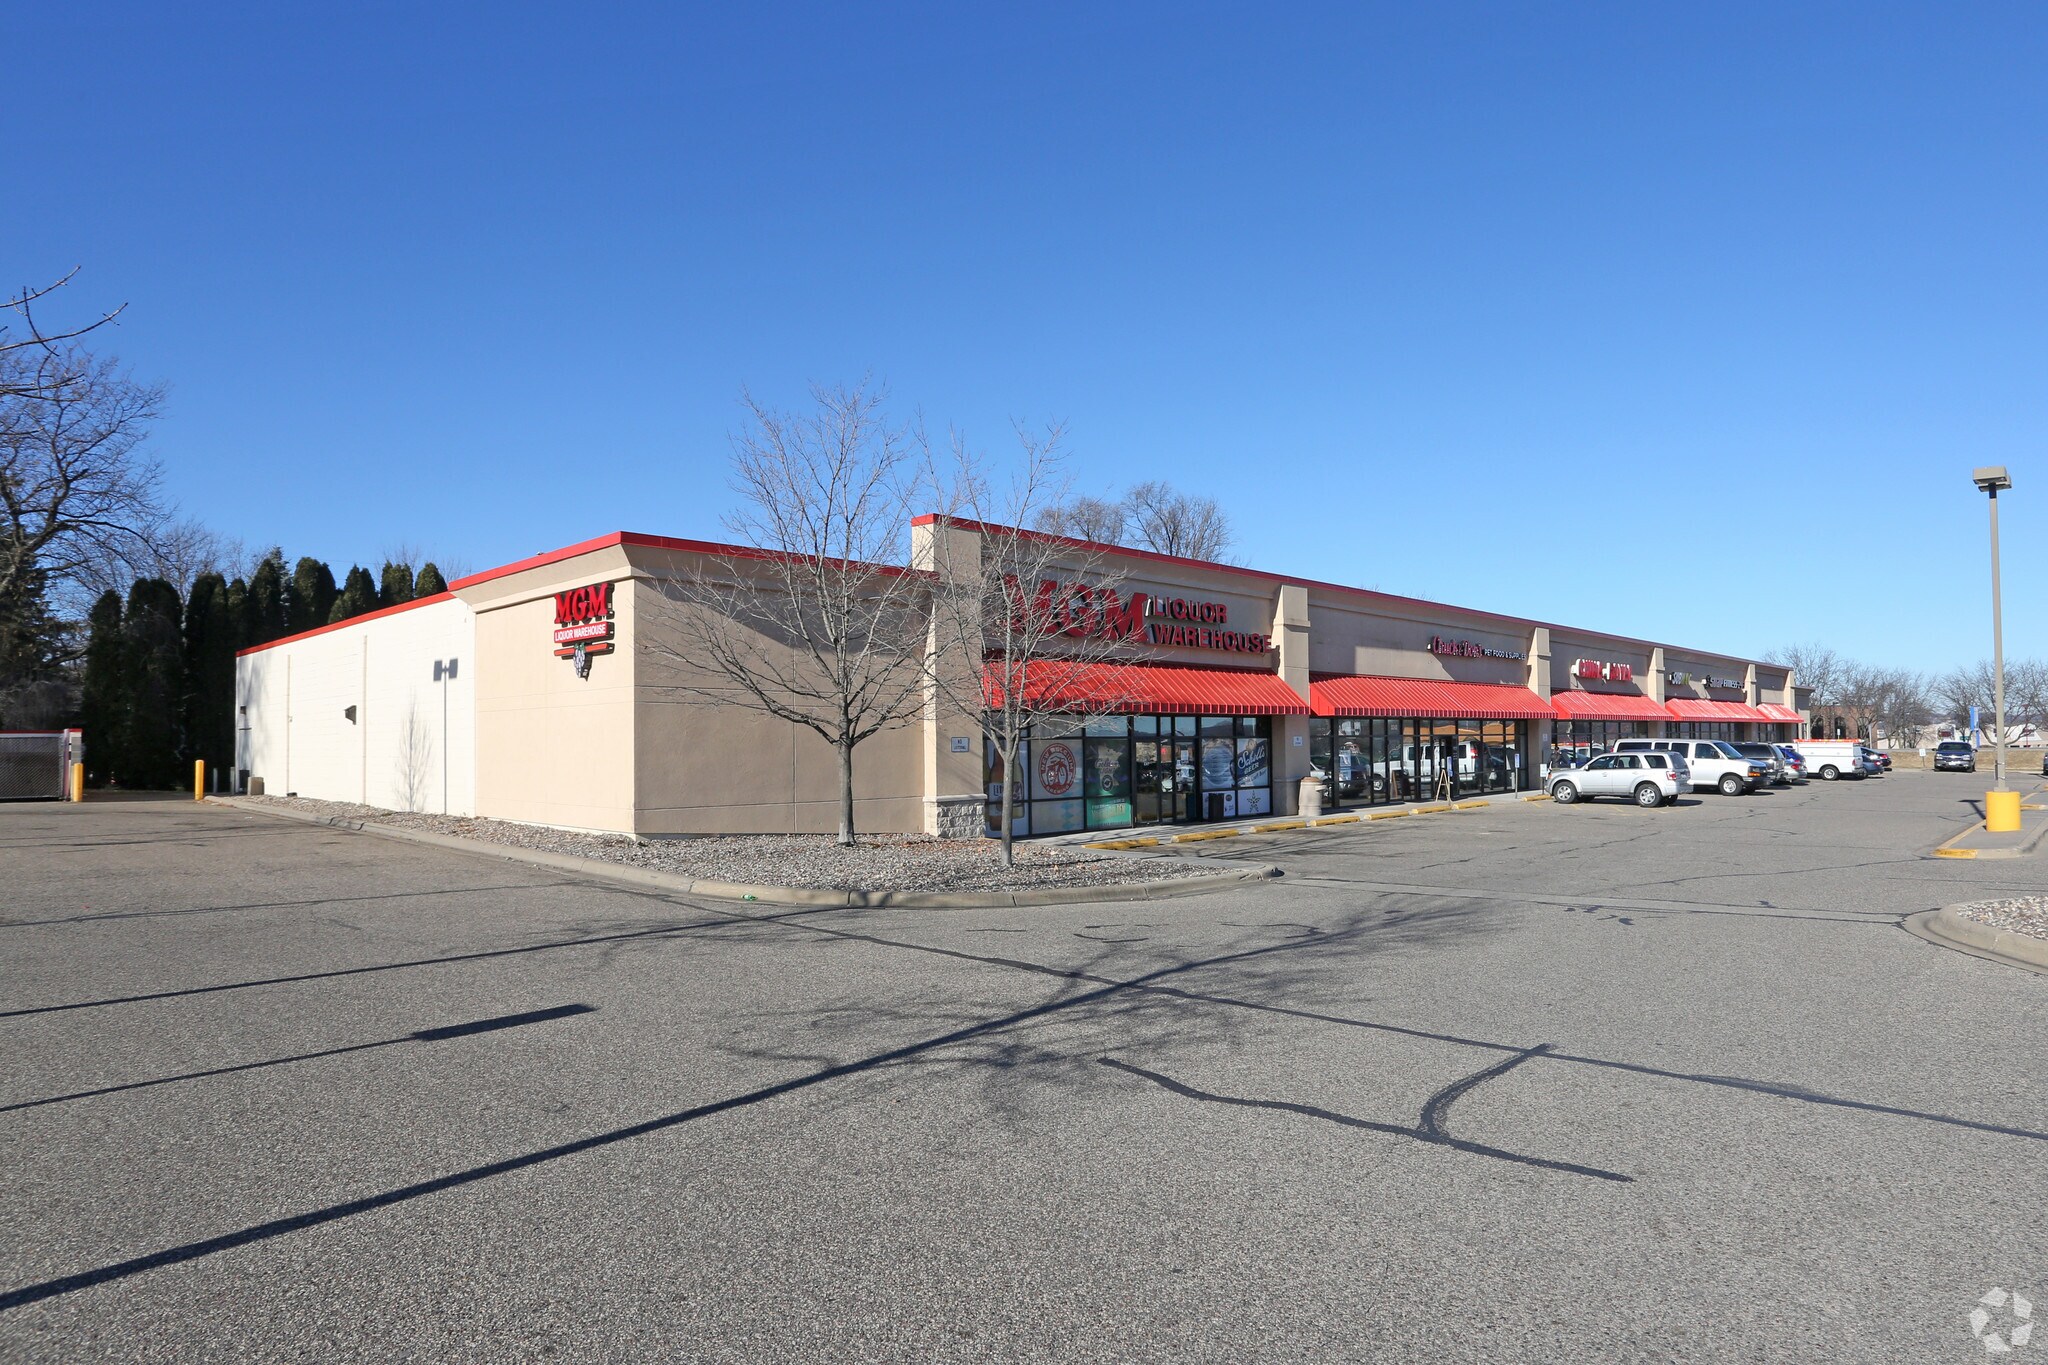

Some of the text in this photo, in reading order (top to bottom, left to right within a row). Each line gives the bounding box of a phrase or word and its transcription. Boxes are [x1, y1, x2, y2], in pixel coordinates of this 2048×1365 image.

[554, 583, 610, 624] MGM
[1003, 573, 1148, 642] MGM
[1152, 598, 1227, 623] LIQUOR
[555, 624, 606, 641] LIQUOR WAREHOUSE
[1152, 624, 1272, 653] WAREHOUSE
